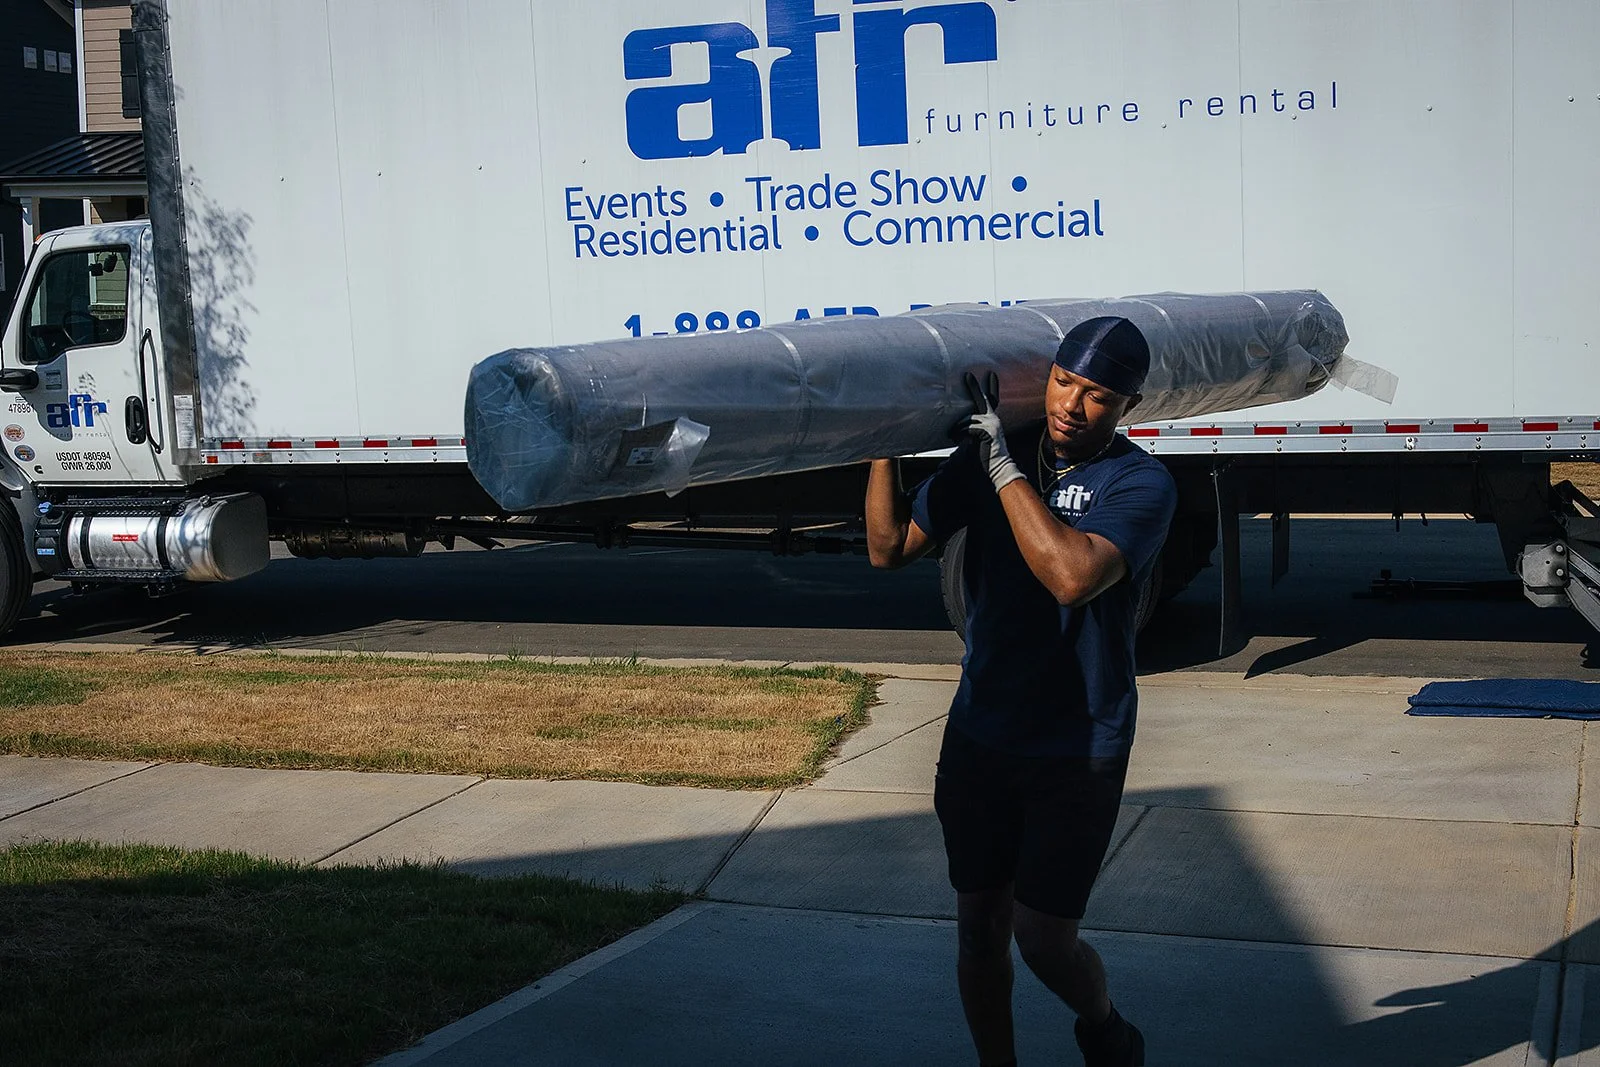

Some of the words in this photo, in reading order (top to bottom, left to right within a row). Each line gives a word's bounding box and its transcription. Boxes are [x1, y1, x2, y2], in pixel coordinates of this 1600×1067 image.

[622, 0, 998, 160] afr
[925, 102, 1140, 134] furniture
[1179, 81, 1338, 119] rental
[565, 184, 688, 222] Events
[744, 172, 858, 213] Trade
[869, 168, 987, 207] Show
[574, 213, 783, 258] Residential
[843, 198, 1105, 247] Commercial
[46, 393, 107, 428] afr
[56, 451, 81, 462] USDOT
[83, 451, 112, 461] 480594
[61, 461, 84, 471] GVWR
[85, 461, 112, 471] 26,000
[1050, 485, 1091, 509] afr
